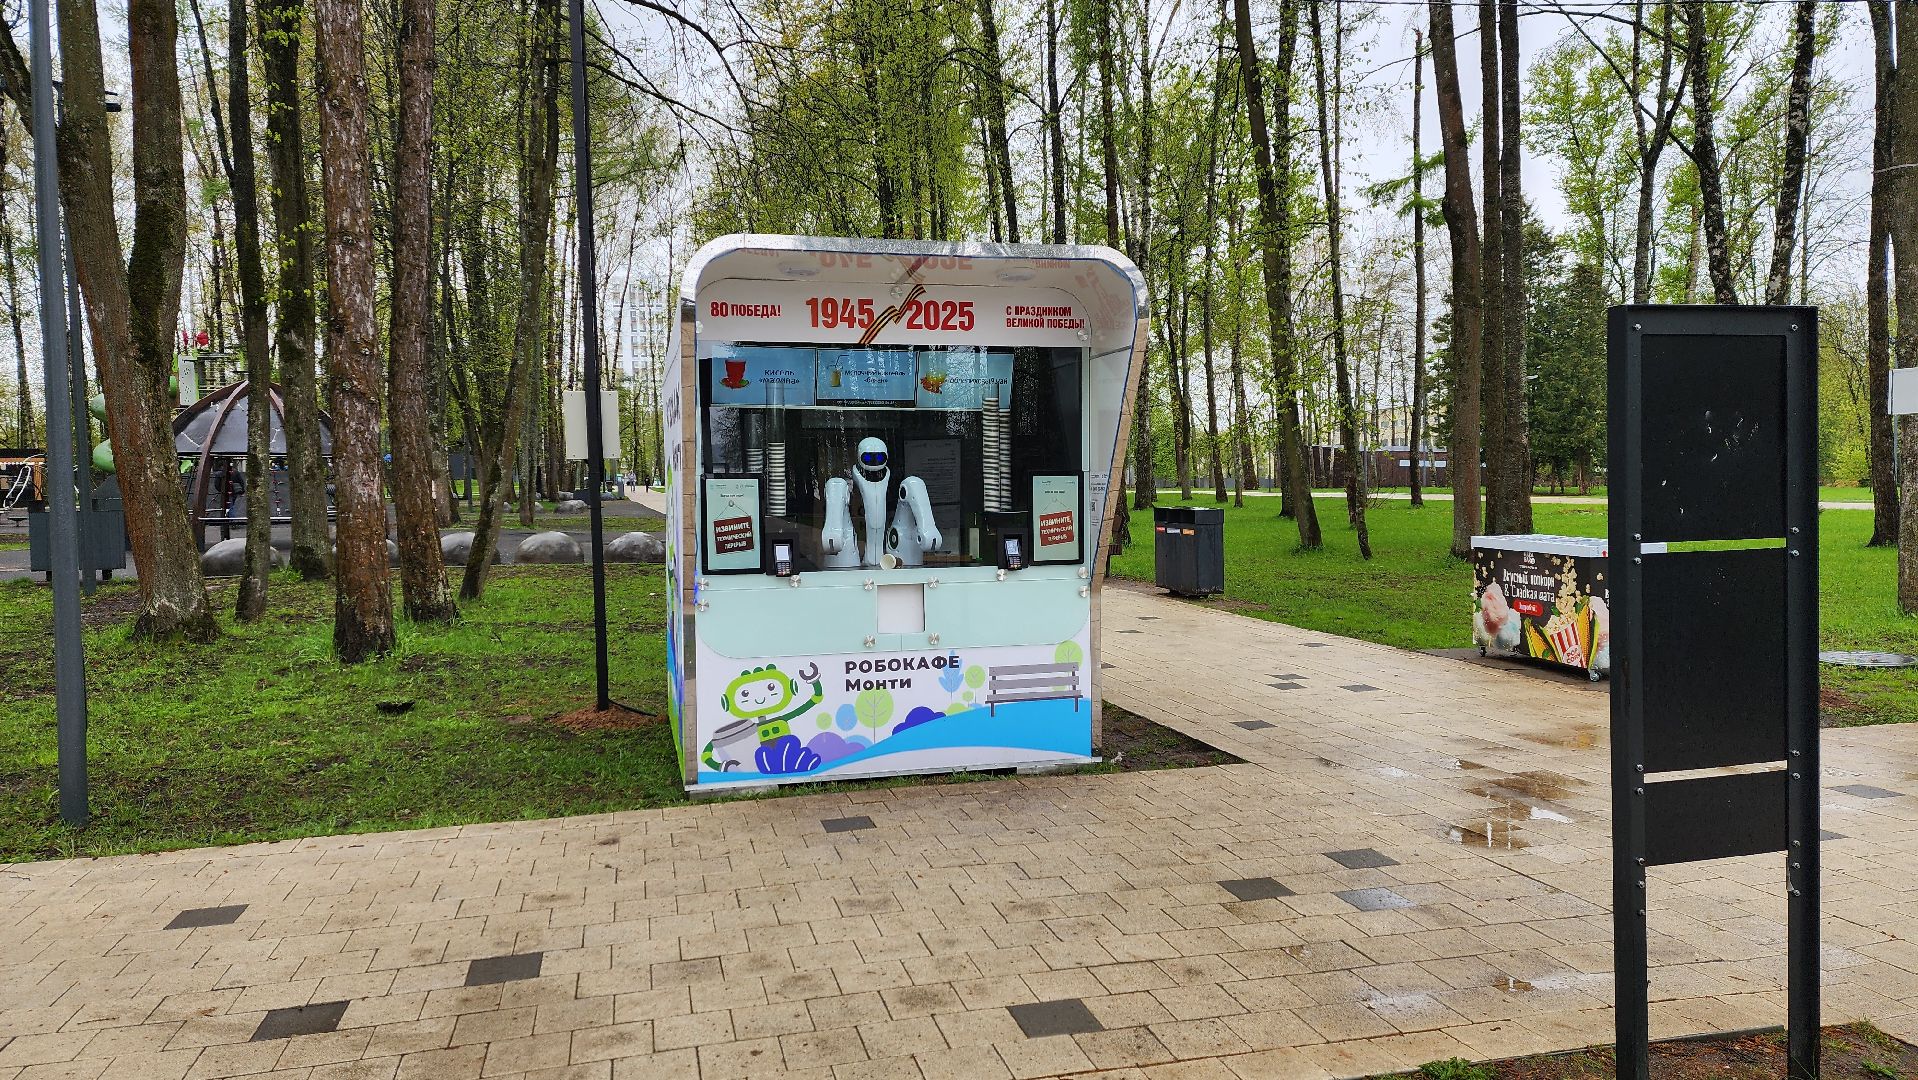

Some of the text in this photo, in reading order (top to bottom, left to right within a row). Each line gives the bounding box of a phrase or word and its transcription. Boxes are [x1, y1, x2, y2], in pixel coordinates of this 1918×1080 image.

[710, 301, 781, 318] 80 ПОБЕДА!
[806, 297, 876, 329] 1945
[906, 299, 975, 331] 2025
[1006, 305, 1072, 318] С ПРАЗДНИКОМ
[1006, 317, 1085, 330] ВЕЛИКОЙ ПОБЕДЫ!
[1504, 584, 1510, 597] &
[1511, 584, 1538, 600] Сладкая
[844, 655, 960, 674] РОБОКАФЕ
[845, 678, 912, 692] Монти
